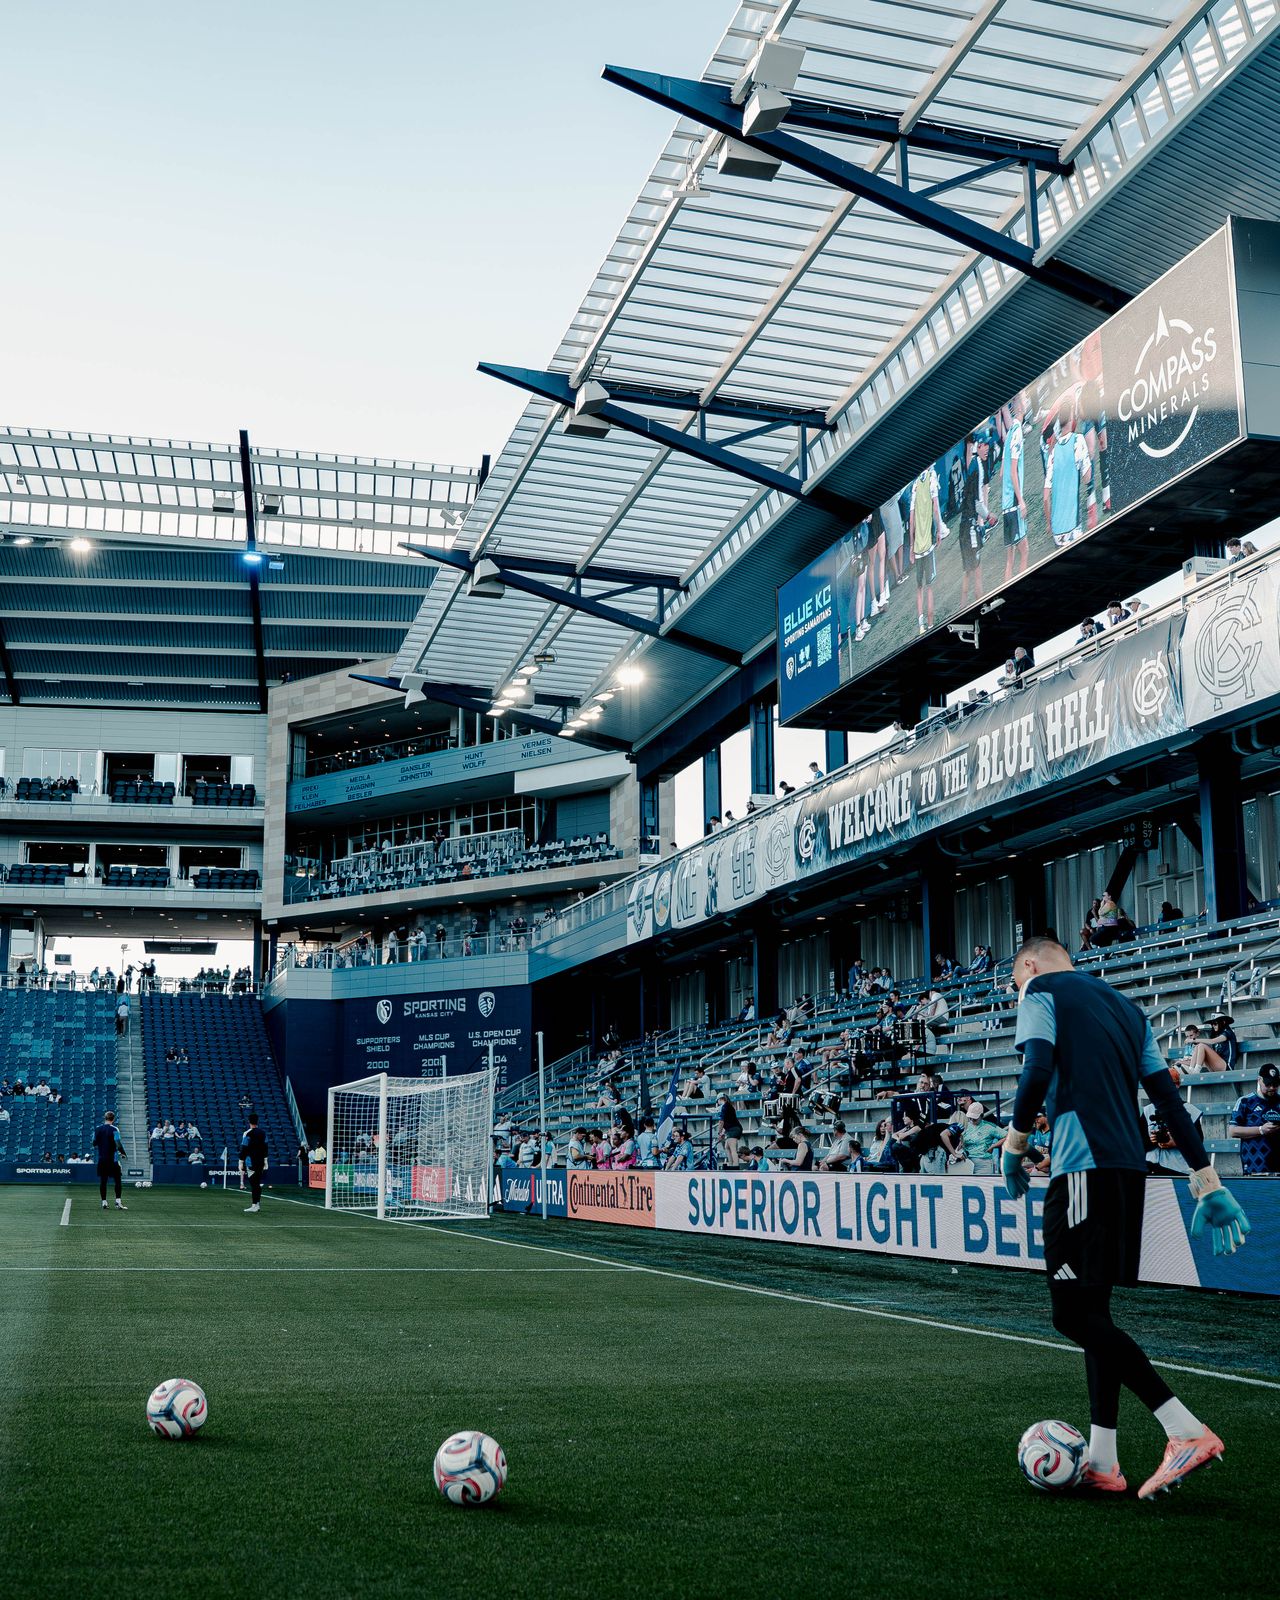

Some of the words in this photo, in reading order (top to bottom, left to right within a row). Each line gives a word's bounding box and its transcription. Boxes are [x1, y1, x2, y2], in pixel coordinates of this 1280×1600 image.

[1118, 327, 1217, 422] COMPASS
[1128, 373, 1210, 443] MINERALS
[784, 598, 813, 635] BLUE
[815, 584, 831, 612] KC
[521, 738, 552, 749] VERMES
[464, 752, 484, 761] HUNT
[521, 747, 552, 759] NIELSEN
[462, 760, 486, 770] WOLFF
[828, 770, 912, 850] WELCOME
[921, 767, 937, 806] TO
[942, 752, 968, 797] THE
[976, 712, 1034, 790] BLUE
[1045, 679, 1110, 762] HELL
[398, 770, 433, 782] JOHNSTON
[345, 782, 376, 792] ZAVAGNIN
[301, 793, 319, 801] KLEIN
[347, 791, 373, 800] BESLER
[294, 800, 327, 810] FEILHABER
[1142, 820, 1153, 829] S6
[1142, 830, 1153, 838] S7
[404, 997, 466, 1016] SPORTING
[418, 1033, 434, 1041] MLS
[434, 1032, 450, 1041] CUP
[468, 1031, 482, 1039] U.S.
[483, 1030, 504, 1038] OPEN
[505, 1028, 521, 1037] CUP
[356, 1036, 401, 1045] SUPPORTERS
[413, 1041, 455, 1050] CHAMPIONS
[472, 1037, 517, 1047] CHAMPIONS
[366, 1045, 391, 1053] SHIELD
[366, 1060, 390, 1069] 2000
[481, 1055, 508, 1064] 204
[536, 1179, 564, 1206] UTRA
[569, 1174, 620, 1214] Continental
[627, 1175, 653, 1212] Tire
[688, 1177, 822, 1237] SUPERIOR
[834, 1181, 944, 1249] LIGHT
[961, 1185, 1046, 1259] BEE
